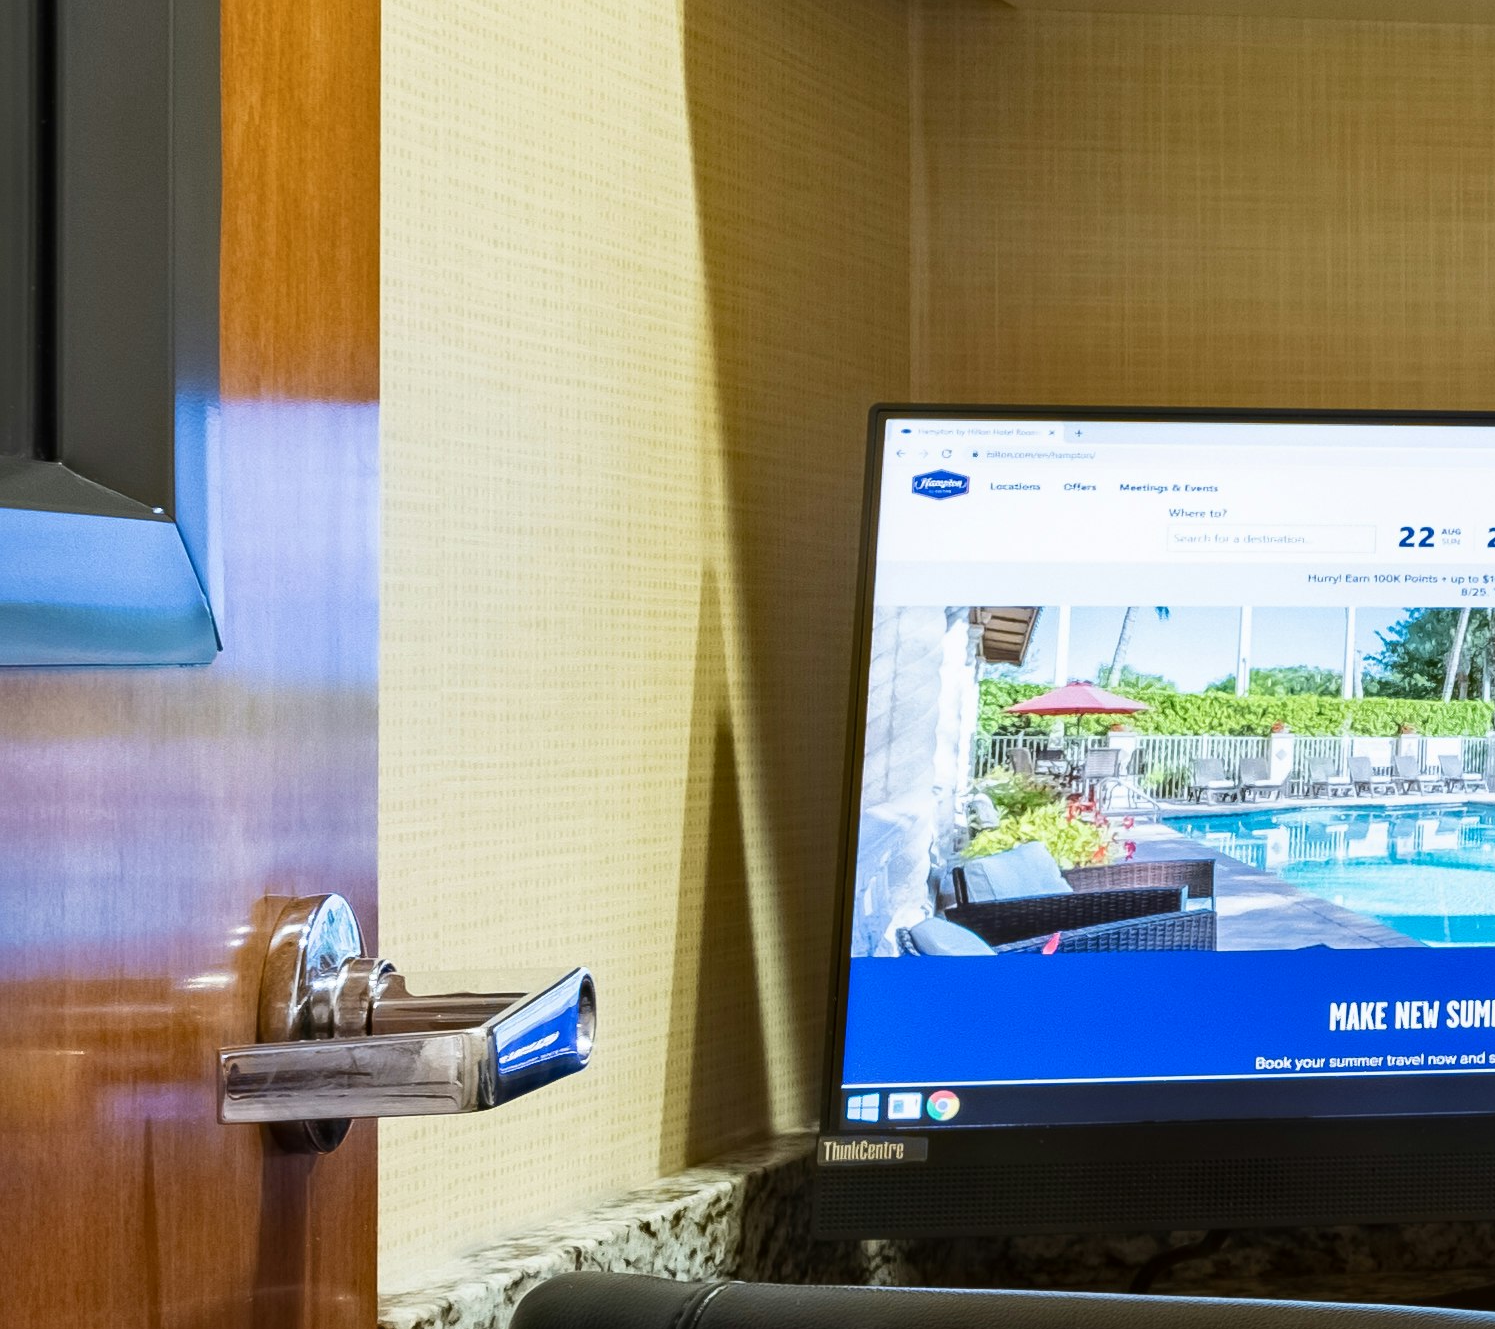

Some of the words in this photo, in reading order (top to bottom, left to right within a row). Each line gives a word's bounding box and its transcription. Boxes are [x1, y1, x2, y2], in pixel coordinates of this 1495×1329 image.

[1398, 526, 1436, 549] 22
[1329, 1002, 1387, 1031] MAKE
[1395, 1001, 1439, 1030] NEW
[1255, 1055, 1292, 1070] Book
[1295, 1057, 1325, 1071] your
[1329, 1055, 1383, 1068] summer
[1386, 1052, 1425, 1067] travel
[1427, 1054, 1457, 1066] now
[1459, 1051, 1486, 1065] and
[823, 1139, 904, 1161] ThinkCentre
